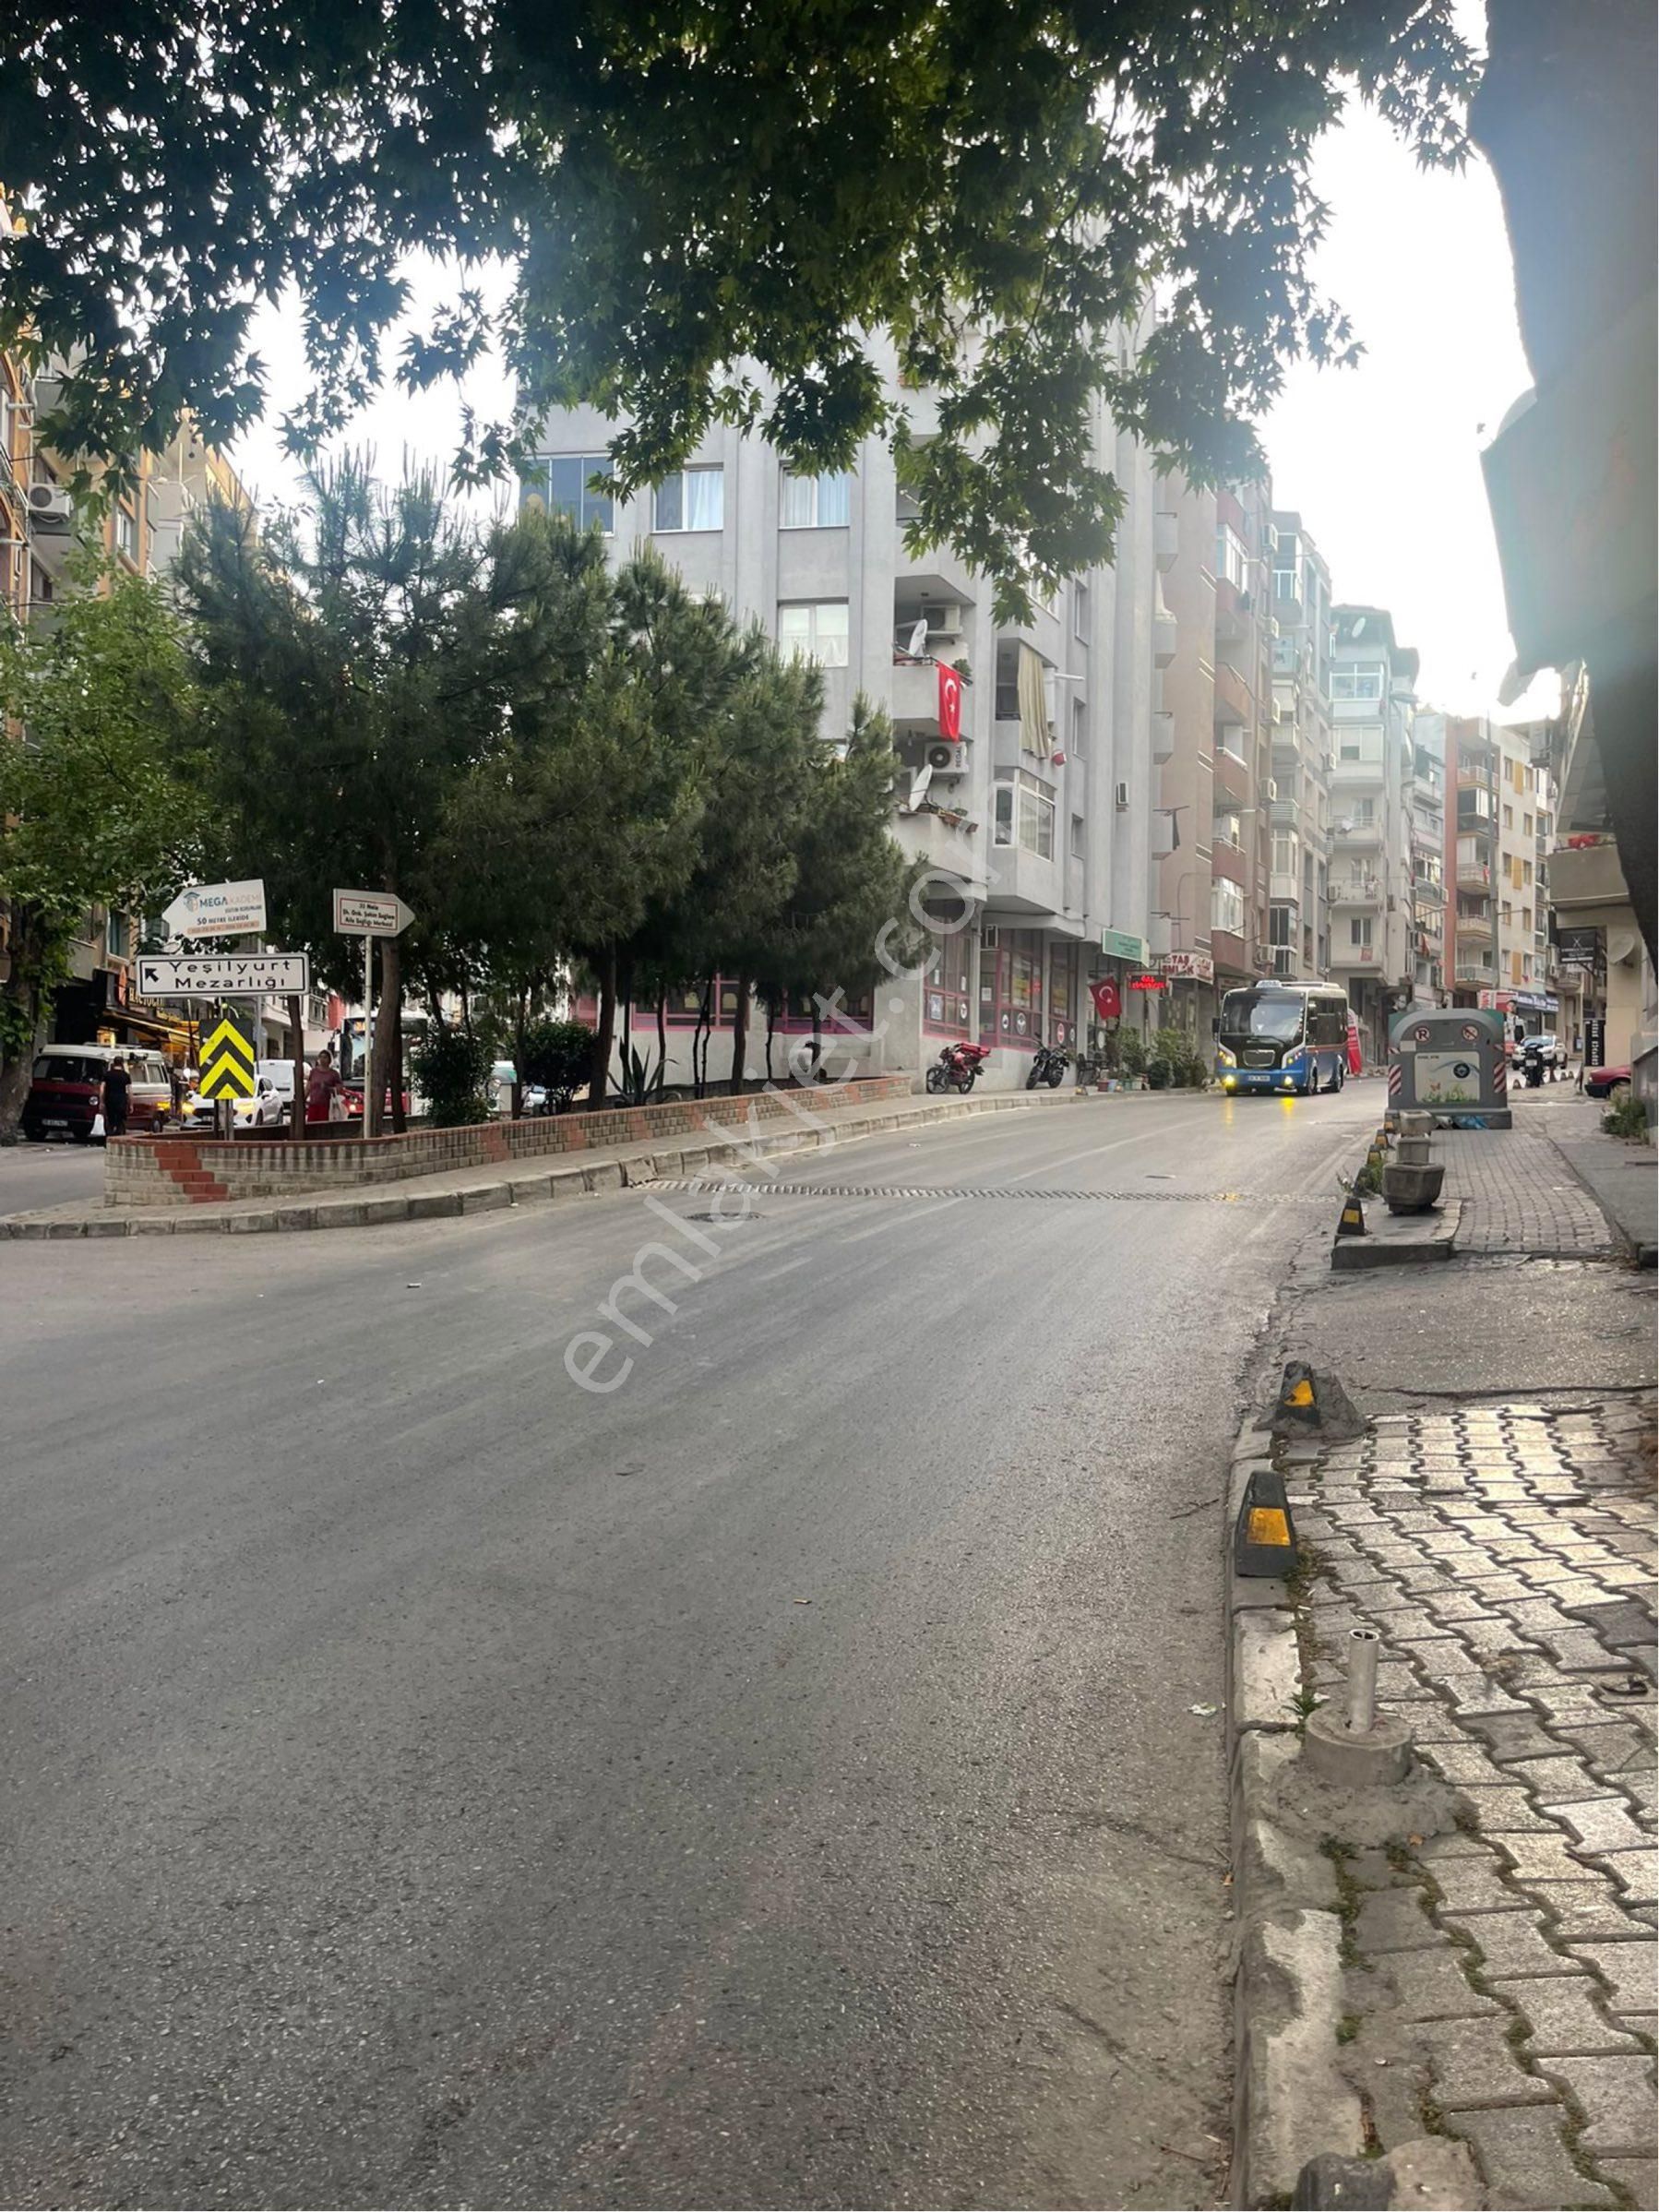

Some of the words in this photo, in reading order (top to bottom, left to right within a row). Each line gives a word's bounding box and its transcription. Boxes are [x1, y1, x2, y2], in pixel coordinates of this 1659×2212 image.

[197, 916, 207, 926] 50
[170, 960, 291, 974] Yeşilyurt
[175, 976, 285, 990] Mezarlığı
